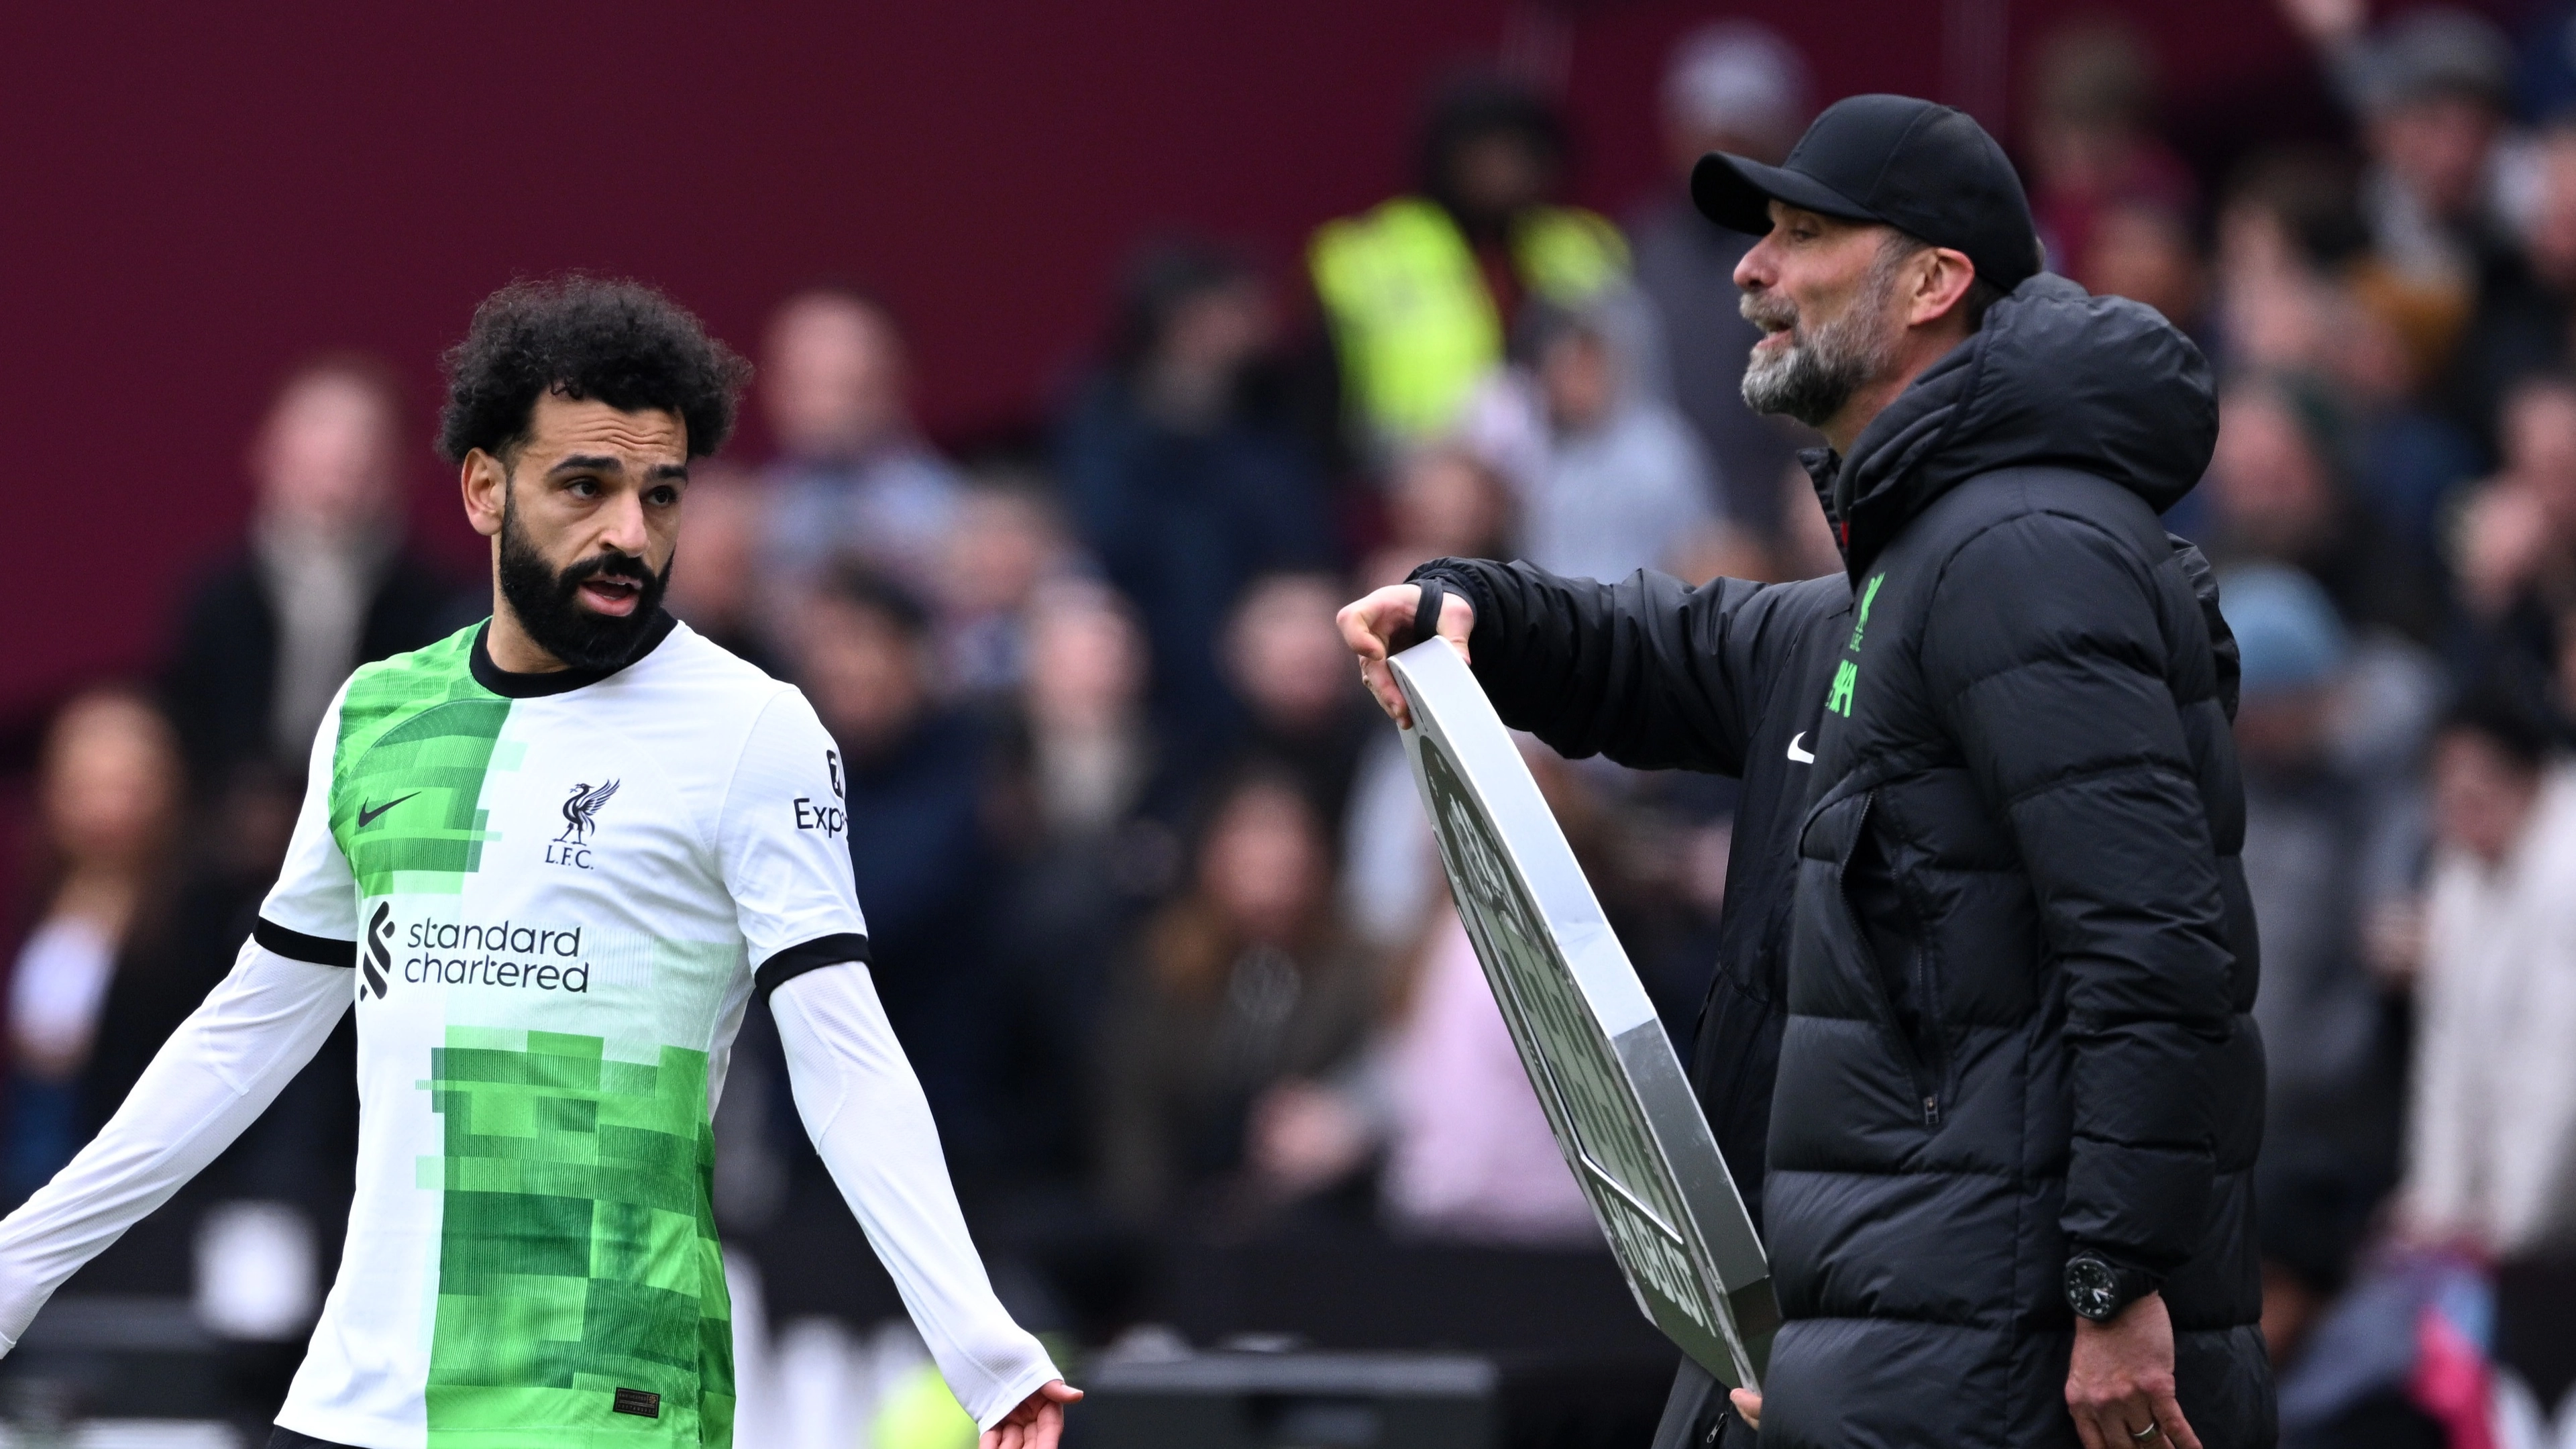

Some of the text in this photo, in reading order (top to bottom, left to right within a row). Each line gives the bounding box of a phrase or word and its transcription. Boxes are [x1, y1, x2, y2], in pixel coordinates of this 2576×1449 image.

[794, 798, 848, 838] Exp
[408, 917, 581, 957] standard
[405, 952, 589, 993] chartered
[1597, 1184, 1717, 1338] HUBLOT
